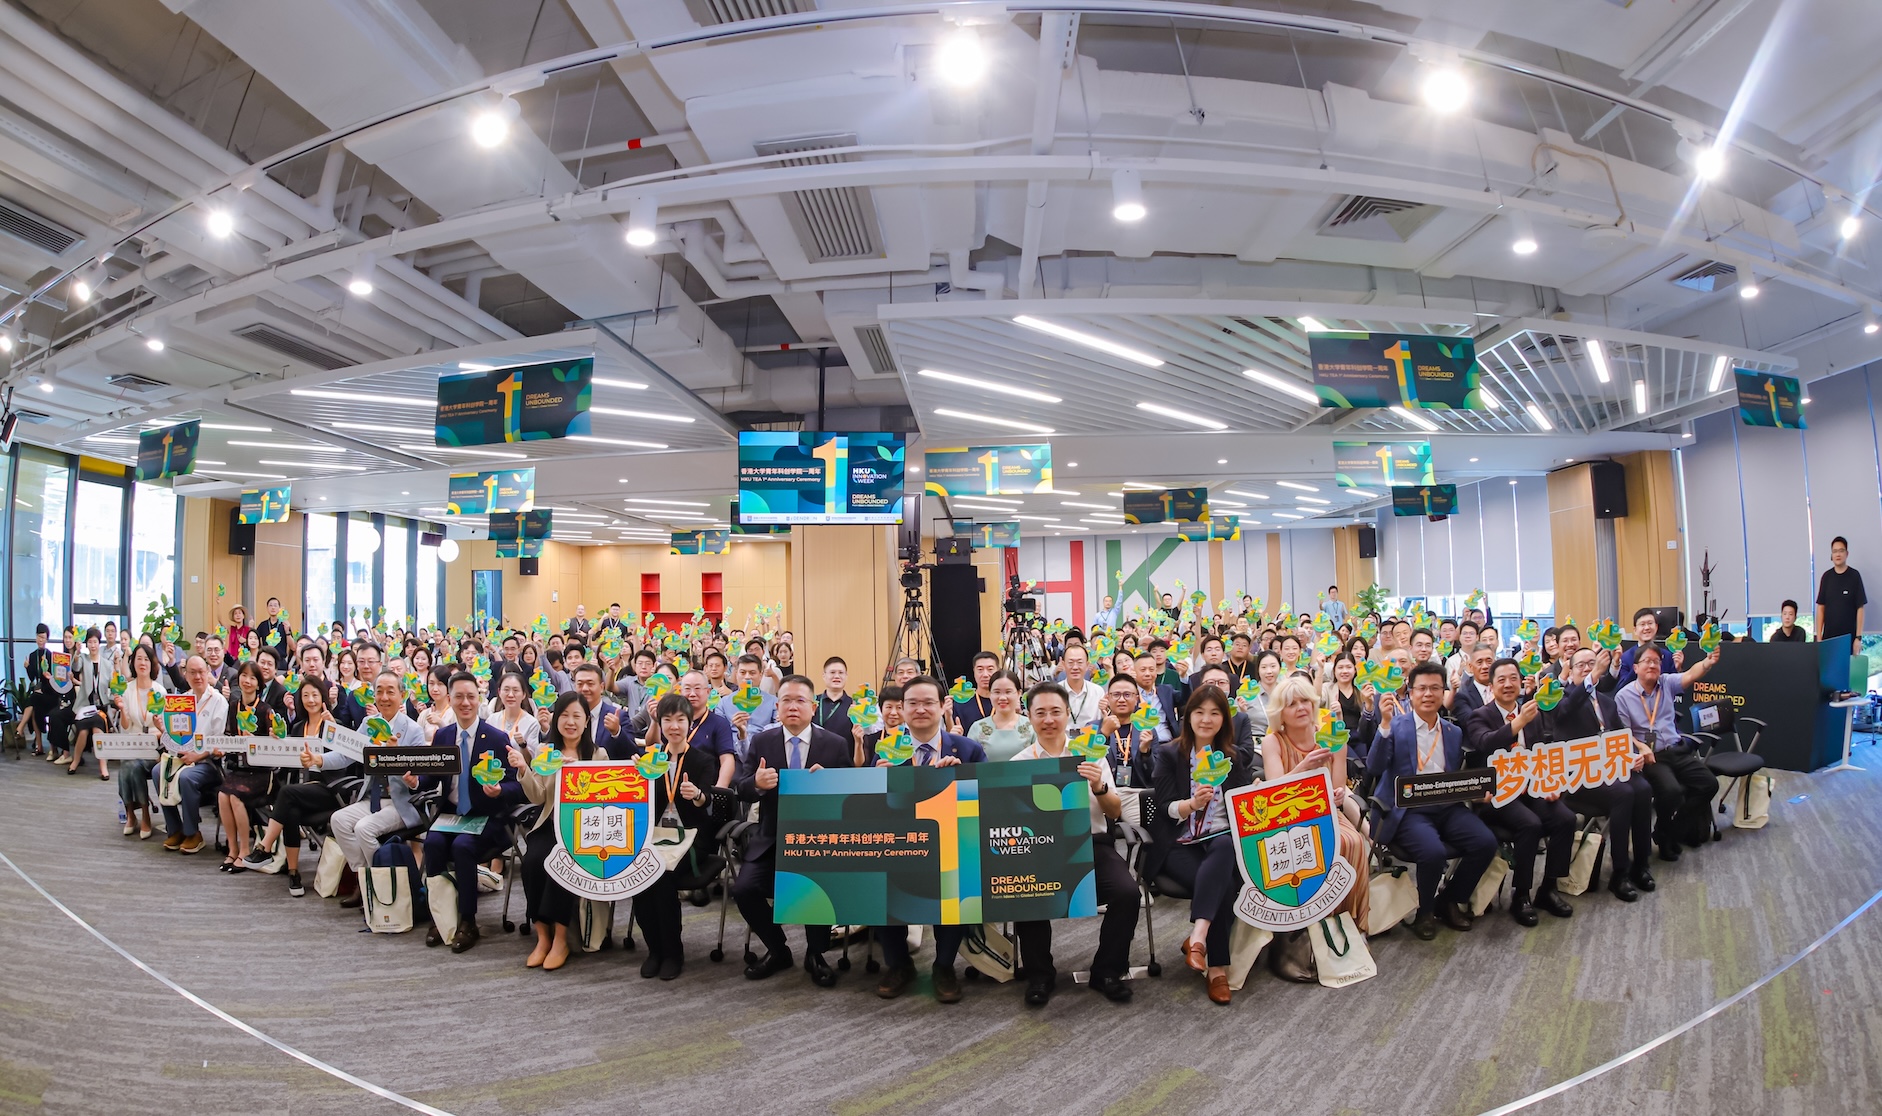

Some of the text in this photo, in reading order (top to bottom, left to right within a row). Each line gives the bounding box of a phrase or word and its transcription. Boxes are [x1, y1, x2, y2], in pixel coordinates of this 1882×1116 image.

[525, 392, 550, 400] DREAMS
[525, 396, 563, 406] UNBOUNDED
[1693, 682, 1727, 694] DREAMS
[378, 754, 441, 762] Techno-Entrepreneurship
[1492, 733, 1634, 802] 梦想无界
[1414, 776, 1492, 790] Techno-Entrepreneurship Core
[1423, 788, 1447, 796] UNIVERSITY
[989, 827, 1022, 838] HKU
[785, 832, 929, 845] 香港大学青年科创学院一周年
[784, 849, 803, 857] HKU
[804, 849, 821, 857] TEA
[831, 849, 882, 858] Anniversary
[884, 849, 929, 857] Ceremony
[999, 845, 1031, 855] WEEK
[553, 861, 656, 892] SAPIENTIA ET VIRTUS
[991, 874, 1036, 885] DREAMS
[991, 882, 1062, 894] UNBOUNDED
[1243, 875, 1347, 922] SAPIENTIA ET VIRTUS
